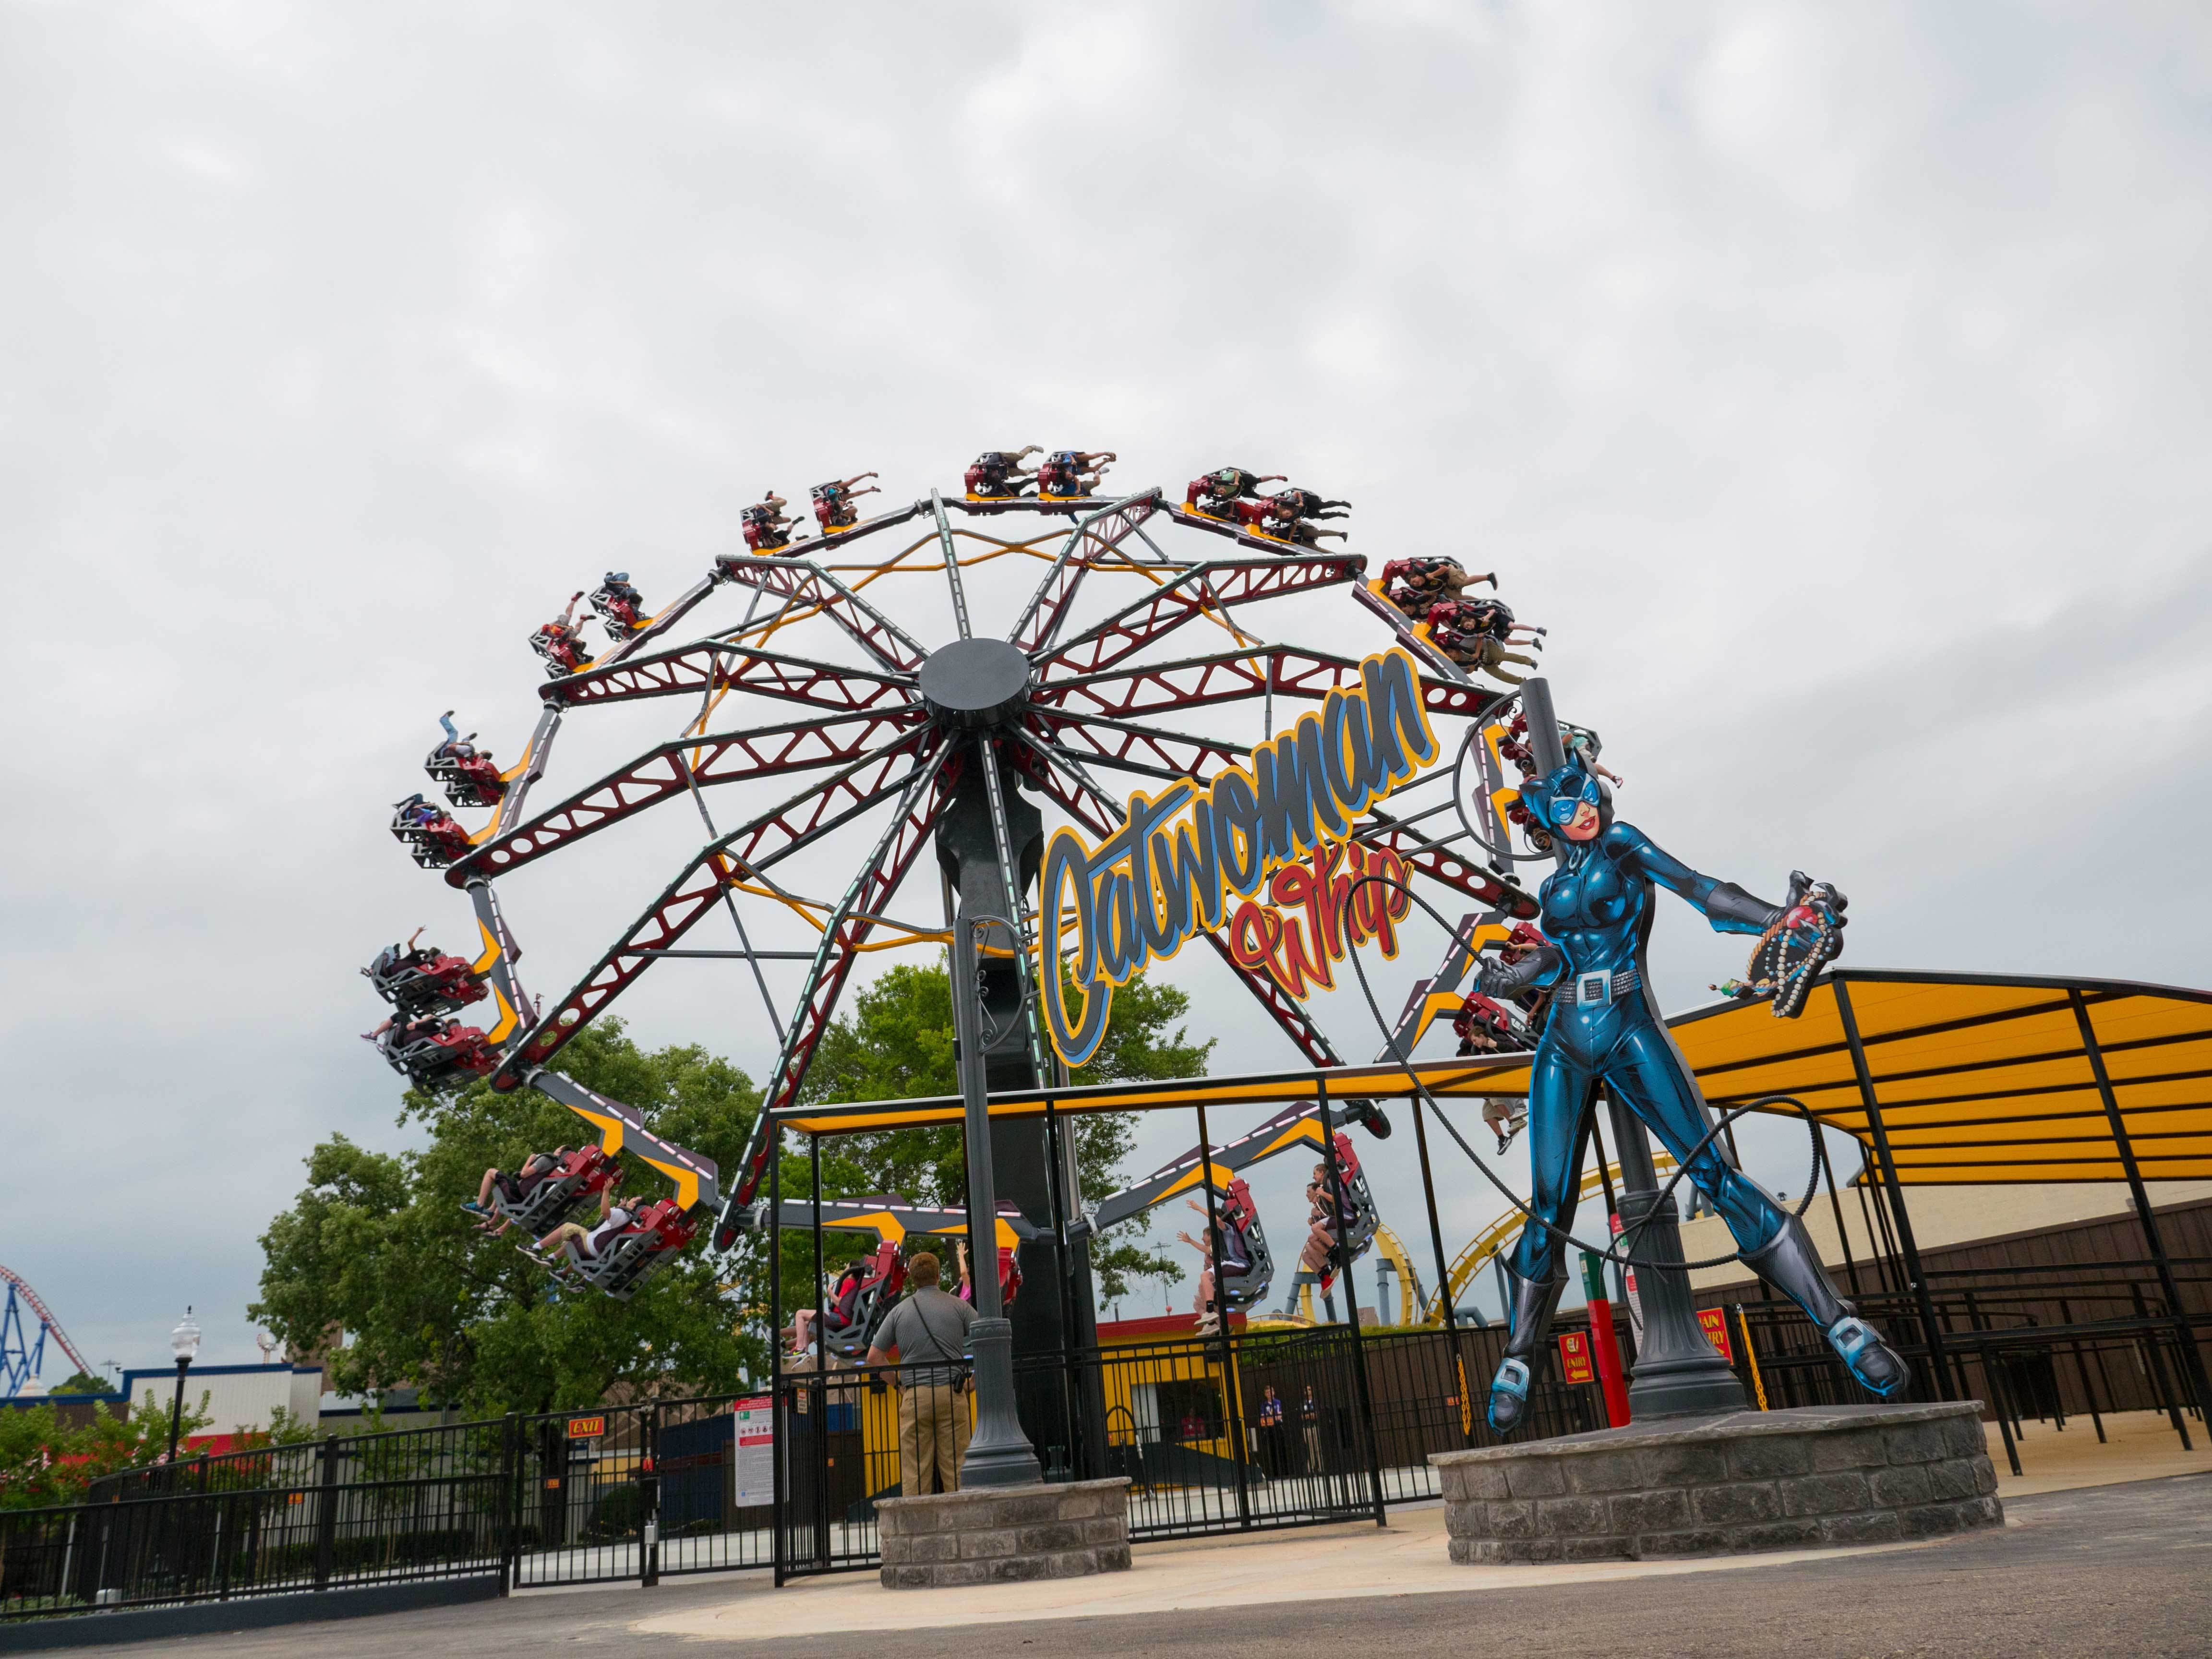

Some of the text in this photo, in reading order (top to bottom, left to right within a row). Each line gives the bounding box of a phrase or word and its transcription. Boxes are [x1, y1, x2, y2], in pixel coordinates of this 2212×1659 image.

[1039, 647, 1439, 1067] Catwoman
[1231, 841, 1414, 1001] Whip
[1699, 1314, 1719, 1328] AIN
[1707, 1330, 1724, 1344] TRY
[1567, 1356, 1586, 1368] ENTRY
[573, 1420, 599, 1433] EXIT
